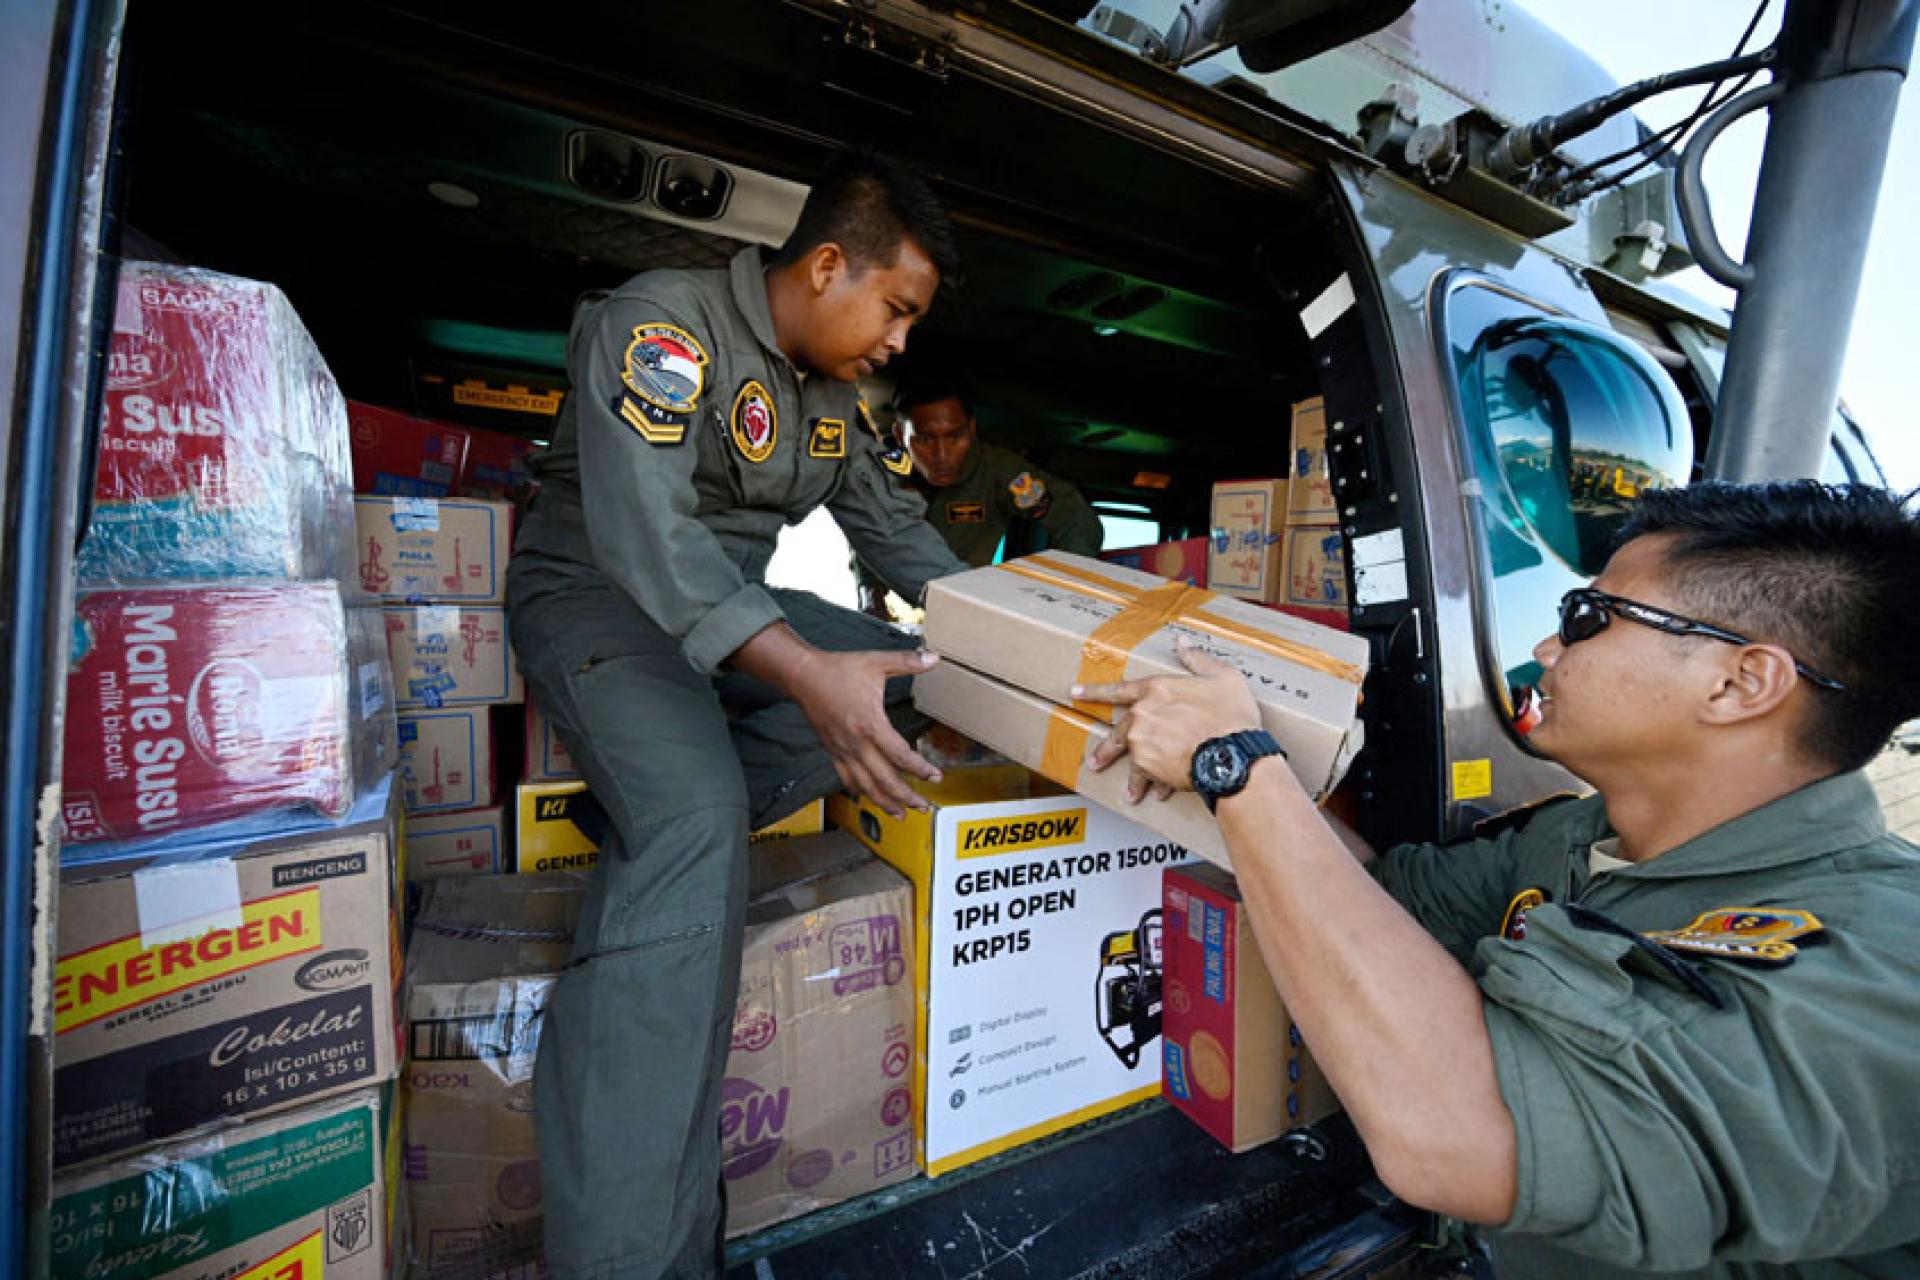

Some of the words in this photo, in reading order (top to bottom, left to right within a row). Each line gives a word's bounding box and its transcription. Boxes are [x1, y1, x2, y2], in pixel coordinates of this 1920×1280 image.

[98, 671, 124, 712] milk
[122, 602, 179, 732] Marie
[102, 714, 128, 781] biscuit
[133, 736, 186, 832] Susu
[963, 816, 1081, 850] KRISBOW
[954, 851, 1112, 897] GENERATOR
[1115, 842, 1189, 870] 1500W
[952, 901, 1001, 931] 1PH
[1007, 888, 1078, 920] OPEN
[53, 908, 303, 1017] ENERGEN
[952, 929, 1032, 968] KRP15
[208, 1003, 363, 1067] Cokelat
[222, 1085, 250, 1107] 16
[275, 1072, 301, 1091] 10
[323, 1059, 348, 1078] 35
[353, 1056, 367, 1073] g
